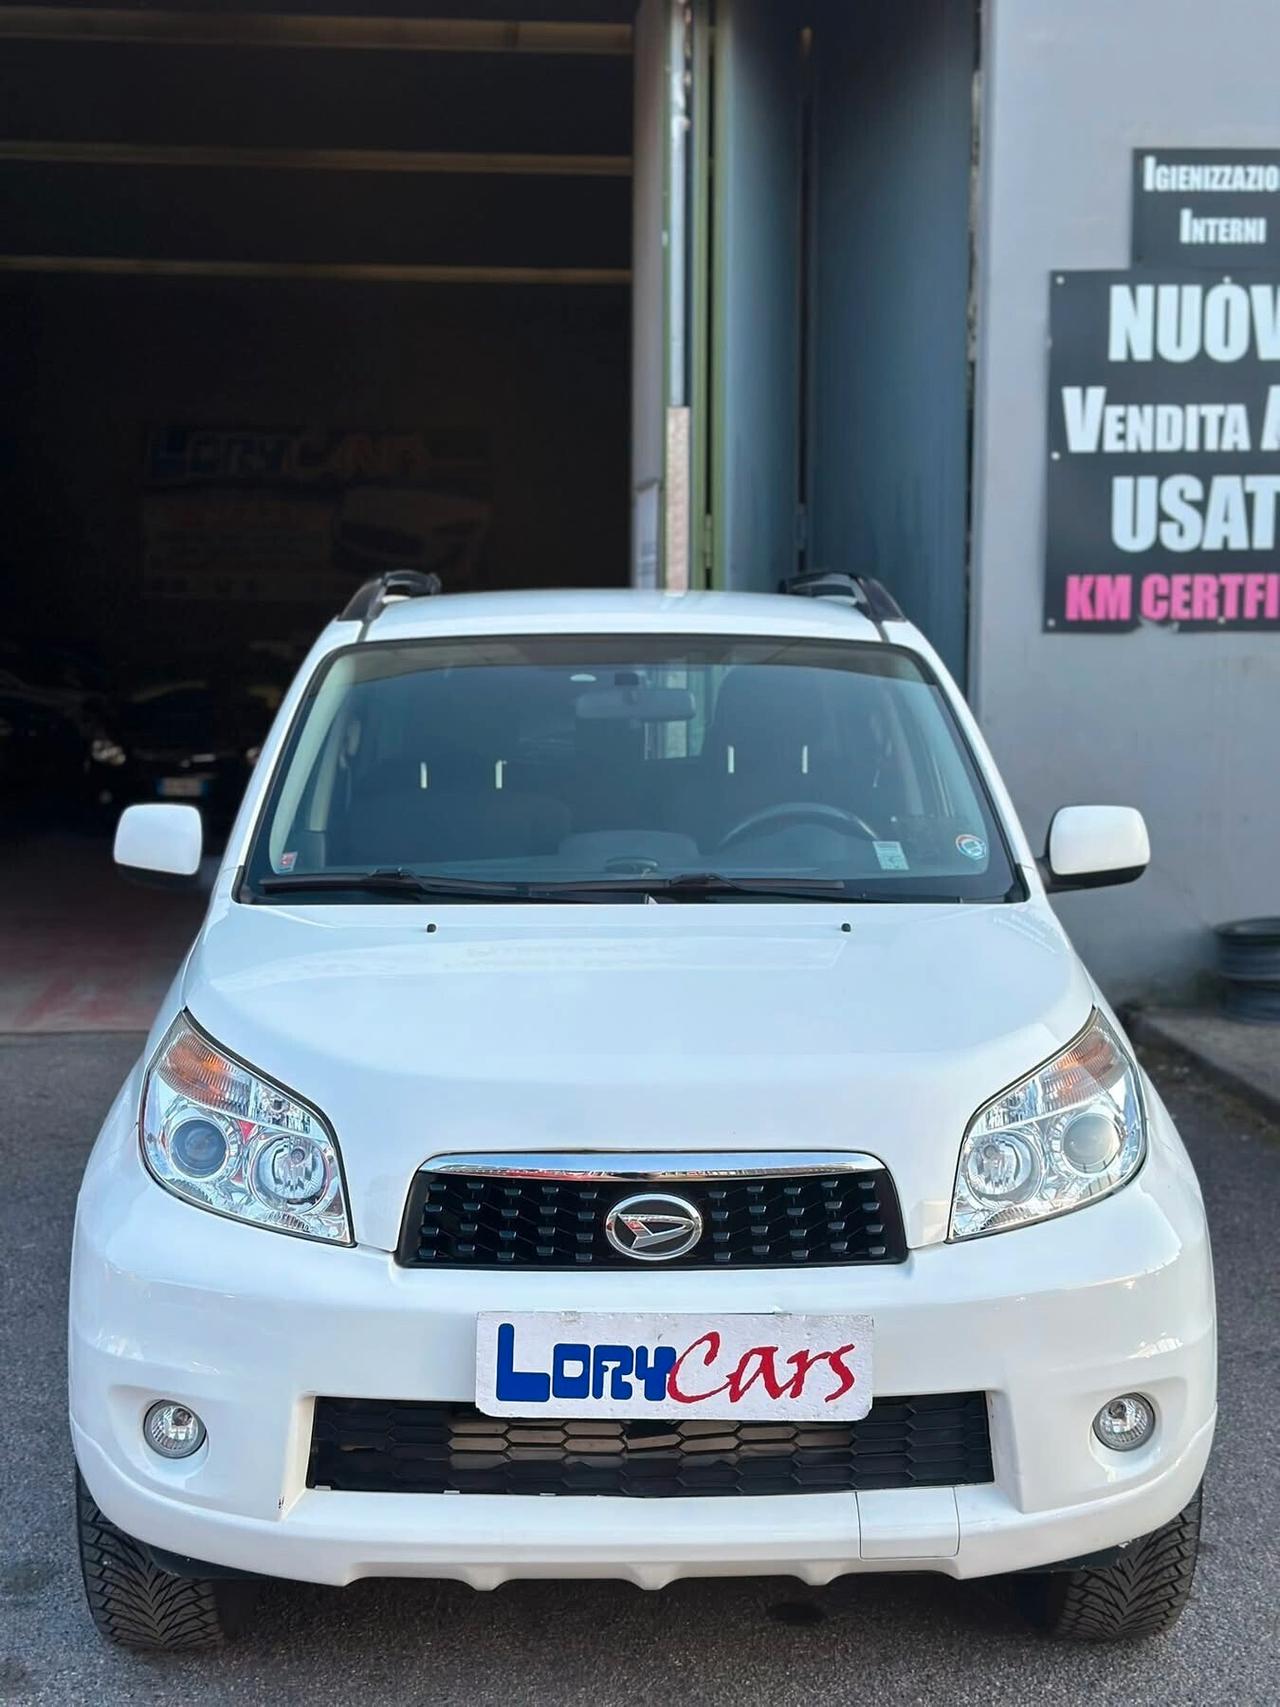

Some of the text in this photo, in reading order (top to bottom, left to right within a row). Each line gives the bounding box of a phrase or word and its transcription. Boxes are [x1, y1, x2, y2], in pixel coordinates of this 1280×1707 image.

[1144, 157, 1279, 191] IGIENIZZAZIO
[1181, 209, 1266, 243] INTERNI
[1109, 284, 1280, 362] NUOV
[1062, 387, 1250, 453] VENDITA
[1112, 475, 1280, 552] USAT
[1066, 574, 1279, 621] KM CERTFI
